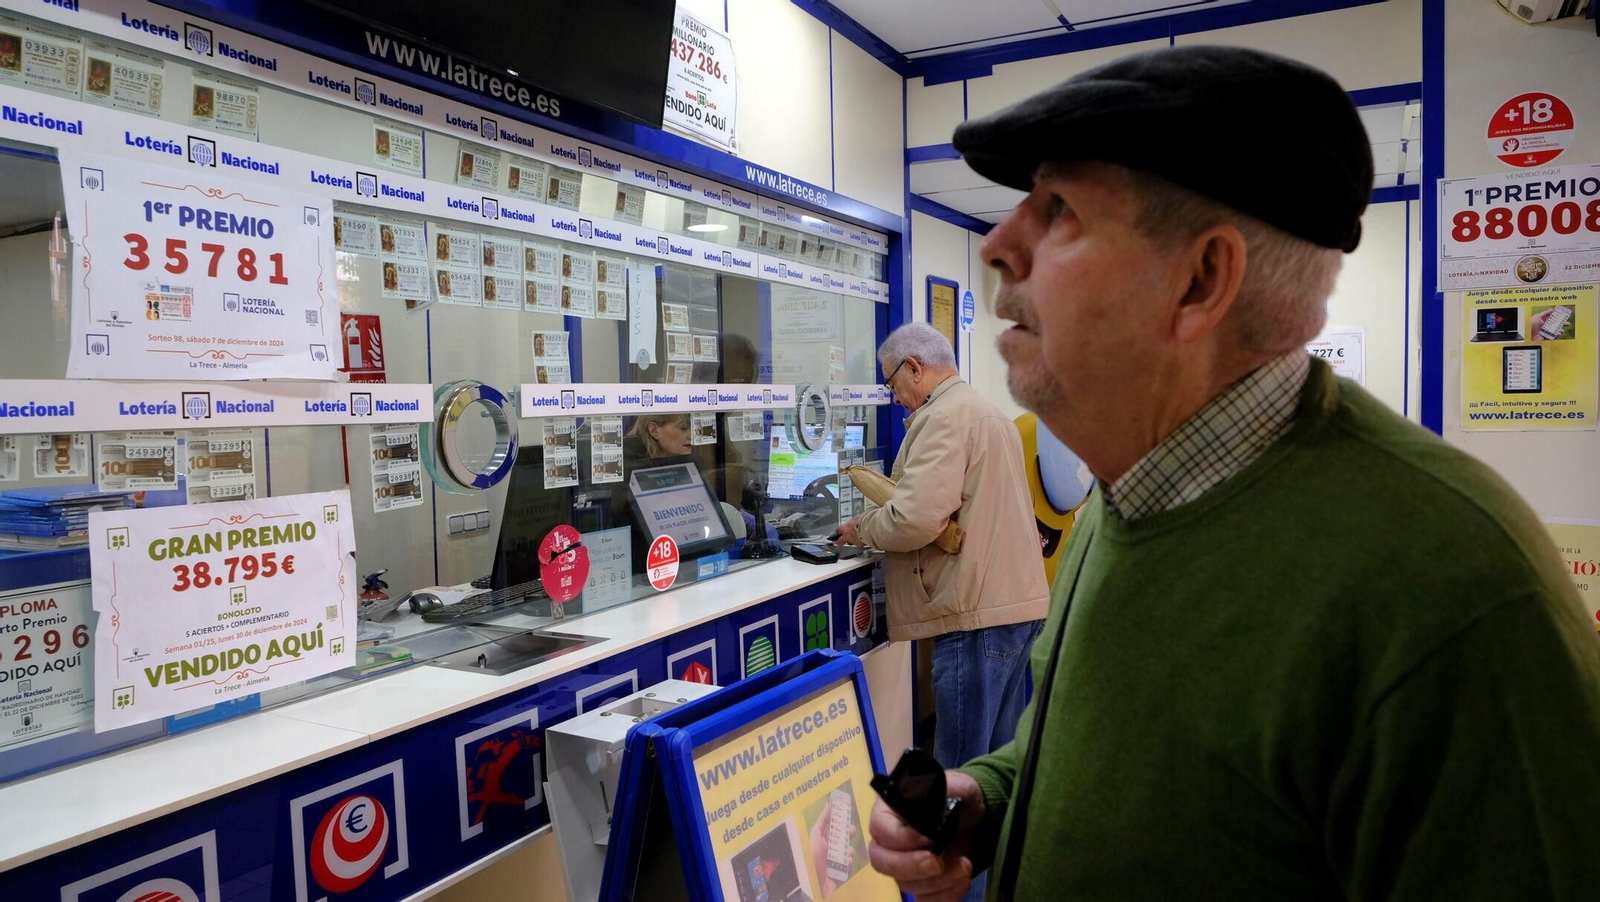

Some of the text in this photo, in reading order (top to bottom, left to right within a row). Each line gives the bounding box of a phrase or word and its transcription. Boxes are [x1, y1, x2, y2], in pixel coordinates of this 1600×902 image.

[681, 16, 707, 38] PREMIO
[25, 40, 65, 57] 03933
[121, 12, 277, 72] Lotería Nacional
[673, 25, 715, 56] MILLONARIO
[114, 66, 150, 82] 40539
[364, 31, 561, 118] www.latrece.es
[216, 92, 246, 104] 98870
[308, 70, 424, 116] Lotería Nacional
[685, 90, 717, 110] Bono Loto
[2, 105, 83, 136] Nacional
[1504, 98, 1554, 125] +18
[446, 113, 535, 149] Lotería Nacional
[704, 112, 726, 132] AQUÍ
[1523, 123, 1566, 131] RESPONSABILIDAD
[125, 131, 280, 176] Lotería Nacional
[551, 144, 622, 174] Lotería Nacional
[634, 168, 692, 192] Lotería Nacional
[1506, 168, 1561, 180] VENDIDO AQUÍ
[310, 170, 425, 203] Lotería Nacional
[746, 164, 828, 206] www.latrece.es
[1486, 177, 1600, 205] PREMIO
[704, 188, 751, 210] Lotería Nacional
[447, 197, 535, 224] Lotería Nacional
[143, 200, 274, 240] 1er PREMIO
[343, 220, 366, 230] 48560
[552, 218, 622, 242] Lotería Nacional
[636, 236, 693, 257] Lotería Nacional
[704, 252, 752, 269] Lotería Nacional
[1448, 270, 1473, 278] LOTERÍA
[1515, 287, 1550, 295] cualquier
[1552, 285, 1594, 293] dispositivo
[242, 298, 276, 308] LOTERÍA
[242, 306, 285, 316] NACIONAL
[148, 334, 172, 342] Sorteo
[174, 335, 184, 343] 98,
[186, 335, 210, 344] sábado
[217, 336, 225, 344] de
[226, 337, 258, 346] diciembre
[1337, 348, 1344, 357] €
[222, 362, 248, 370] Almería
[119, 398, 274, 416] Lotería Nacional
[304, 398, 419, 413] Lotería Nacional
[532, 395, 606, 406] Lotería Nacional
[618, 394, 678, 404] Lotería Nacional
[689, 394, 738, 403] Lotería Nacional
[0, 400, 75, 418] Nacional
[1469, 410, 1585, 420] www.latrece.es
[128, 448, 163, 457] 24930
[211, 442, 241, 452] 23295
[102, 461, 134, 476] 100
[188, 456, 216, 470] 100
[212, 486, 243, 495] 23295
[653, 502, 704, 520] BIENVENIDO
[672, 520, 688, 529] PLACER
[148, 520, 316, 562] GRAN PREMIO
[654, 540, 672, 559] +18
[23, 614, 68, 630] Premio
[218, 606, 262, 622] BONOLOTO
[191, 624, 224, 637] ACIERTOS
[230, 611, 289, 629] COMPLEMENTARIO
[164, 618, 308, 655] Semana 01/25, lunes 30 de diciembre de 2024
[43, 652, 82, 673] AQUÍ
[144, 622, 324, 688] VENDIDO AQUÍ
[24, 686, 52, 698] Nacional
[224, 684, 241, 693] Trece
[246, 676, 270, 687] Almería
[29, 700, 60, 712] DICIEMBRE
[12, 723, 42, 735] LOTERÍAS
[699, 697, 848, 791] www.latrece.es
[706, 725, 861, 825] Juega desde cualquier dispositivo
[723, 756, 849, 844] desde casa en nuestra web
